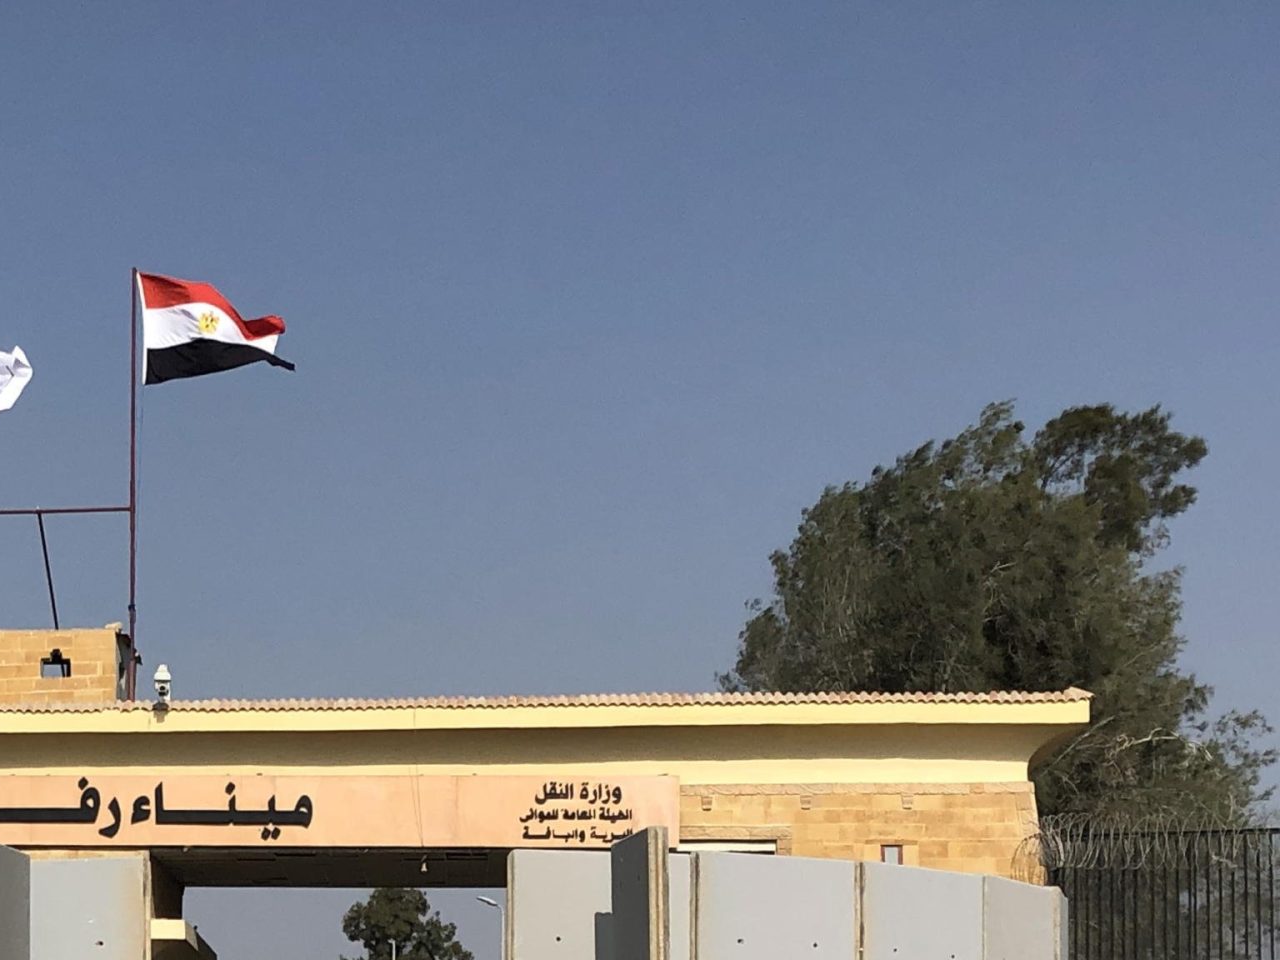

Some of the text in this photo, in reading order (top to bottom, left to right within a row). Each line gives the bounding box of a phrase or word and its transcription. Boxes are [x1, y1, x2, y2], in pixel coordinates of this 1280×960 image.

[534, 781, 623, 805] وزارة النقل
[131, 782, 313, 841] ميناء
[562, 808, 596, 821] العامة
